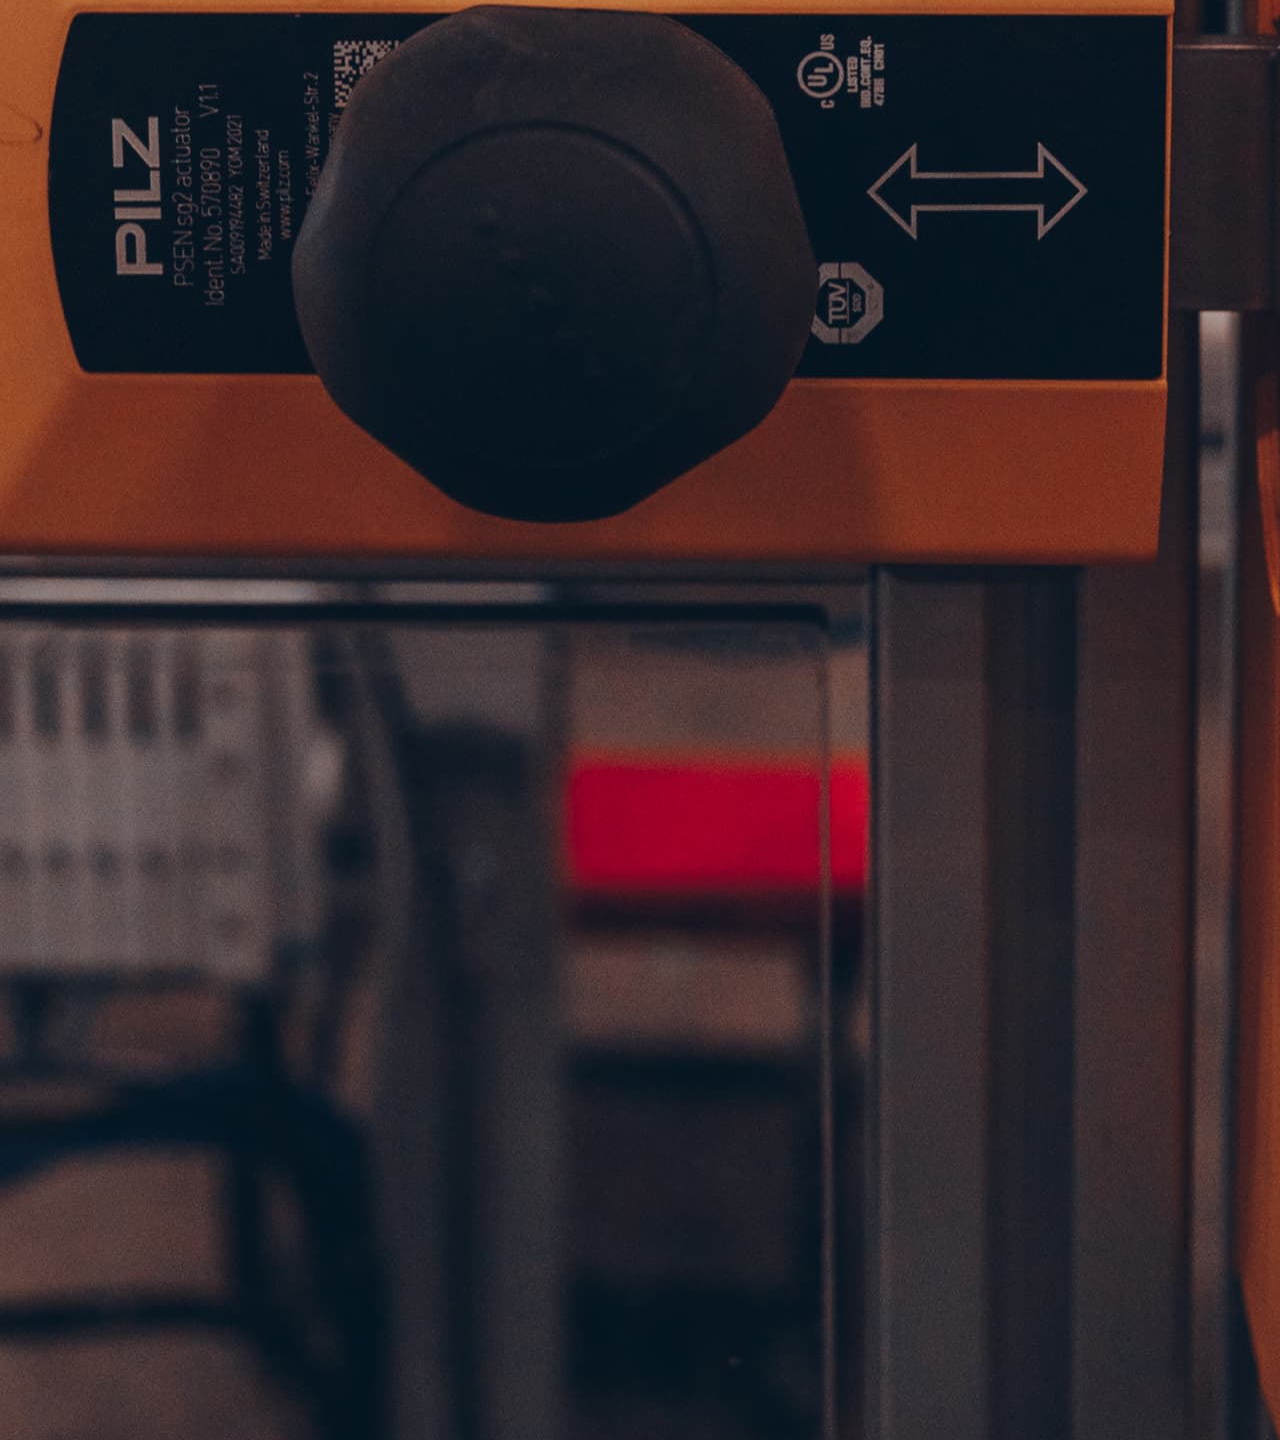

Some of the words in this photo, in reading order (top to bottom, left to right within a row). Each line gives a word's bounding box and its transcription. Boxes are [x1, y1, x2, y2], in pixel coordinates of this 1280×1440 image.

[820, 33, 835, 51] US
[807, 63, 834, 87] UL
[846, 55, 859, 93] LISTED
[198, 83, 220, 118] V1.1
[169, 105, 193, 188] actuator
[227, 114, 243, 145] 2021
[200, 148, 223, 218] 570890
[255, 129, 272, 210] Switzerland
[112, 116, 164, 275] PILZ
[171, 192, 199, 227] sg2
[275, 149, 296, 240] www.pilz.com
[202, 219, 225, 251] No.
[257, 212, 272, 224] in
[172, 230, 195, 287] PSEN
[257, 225, 273, 261] Made
[204, 255, 225, 306] Ident.
